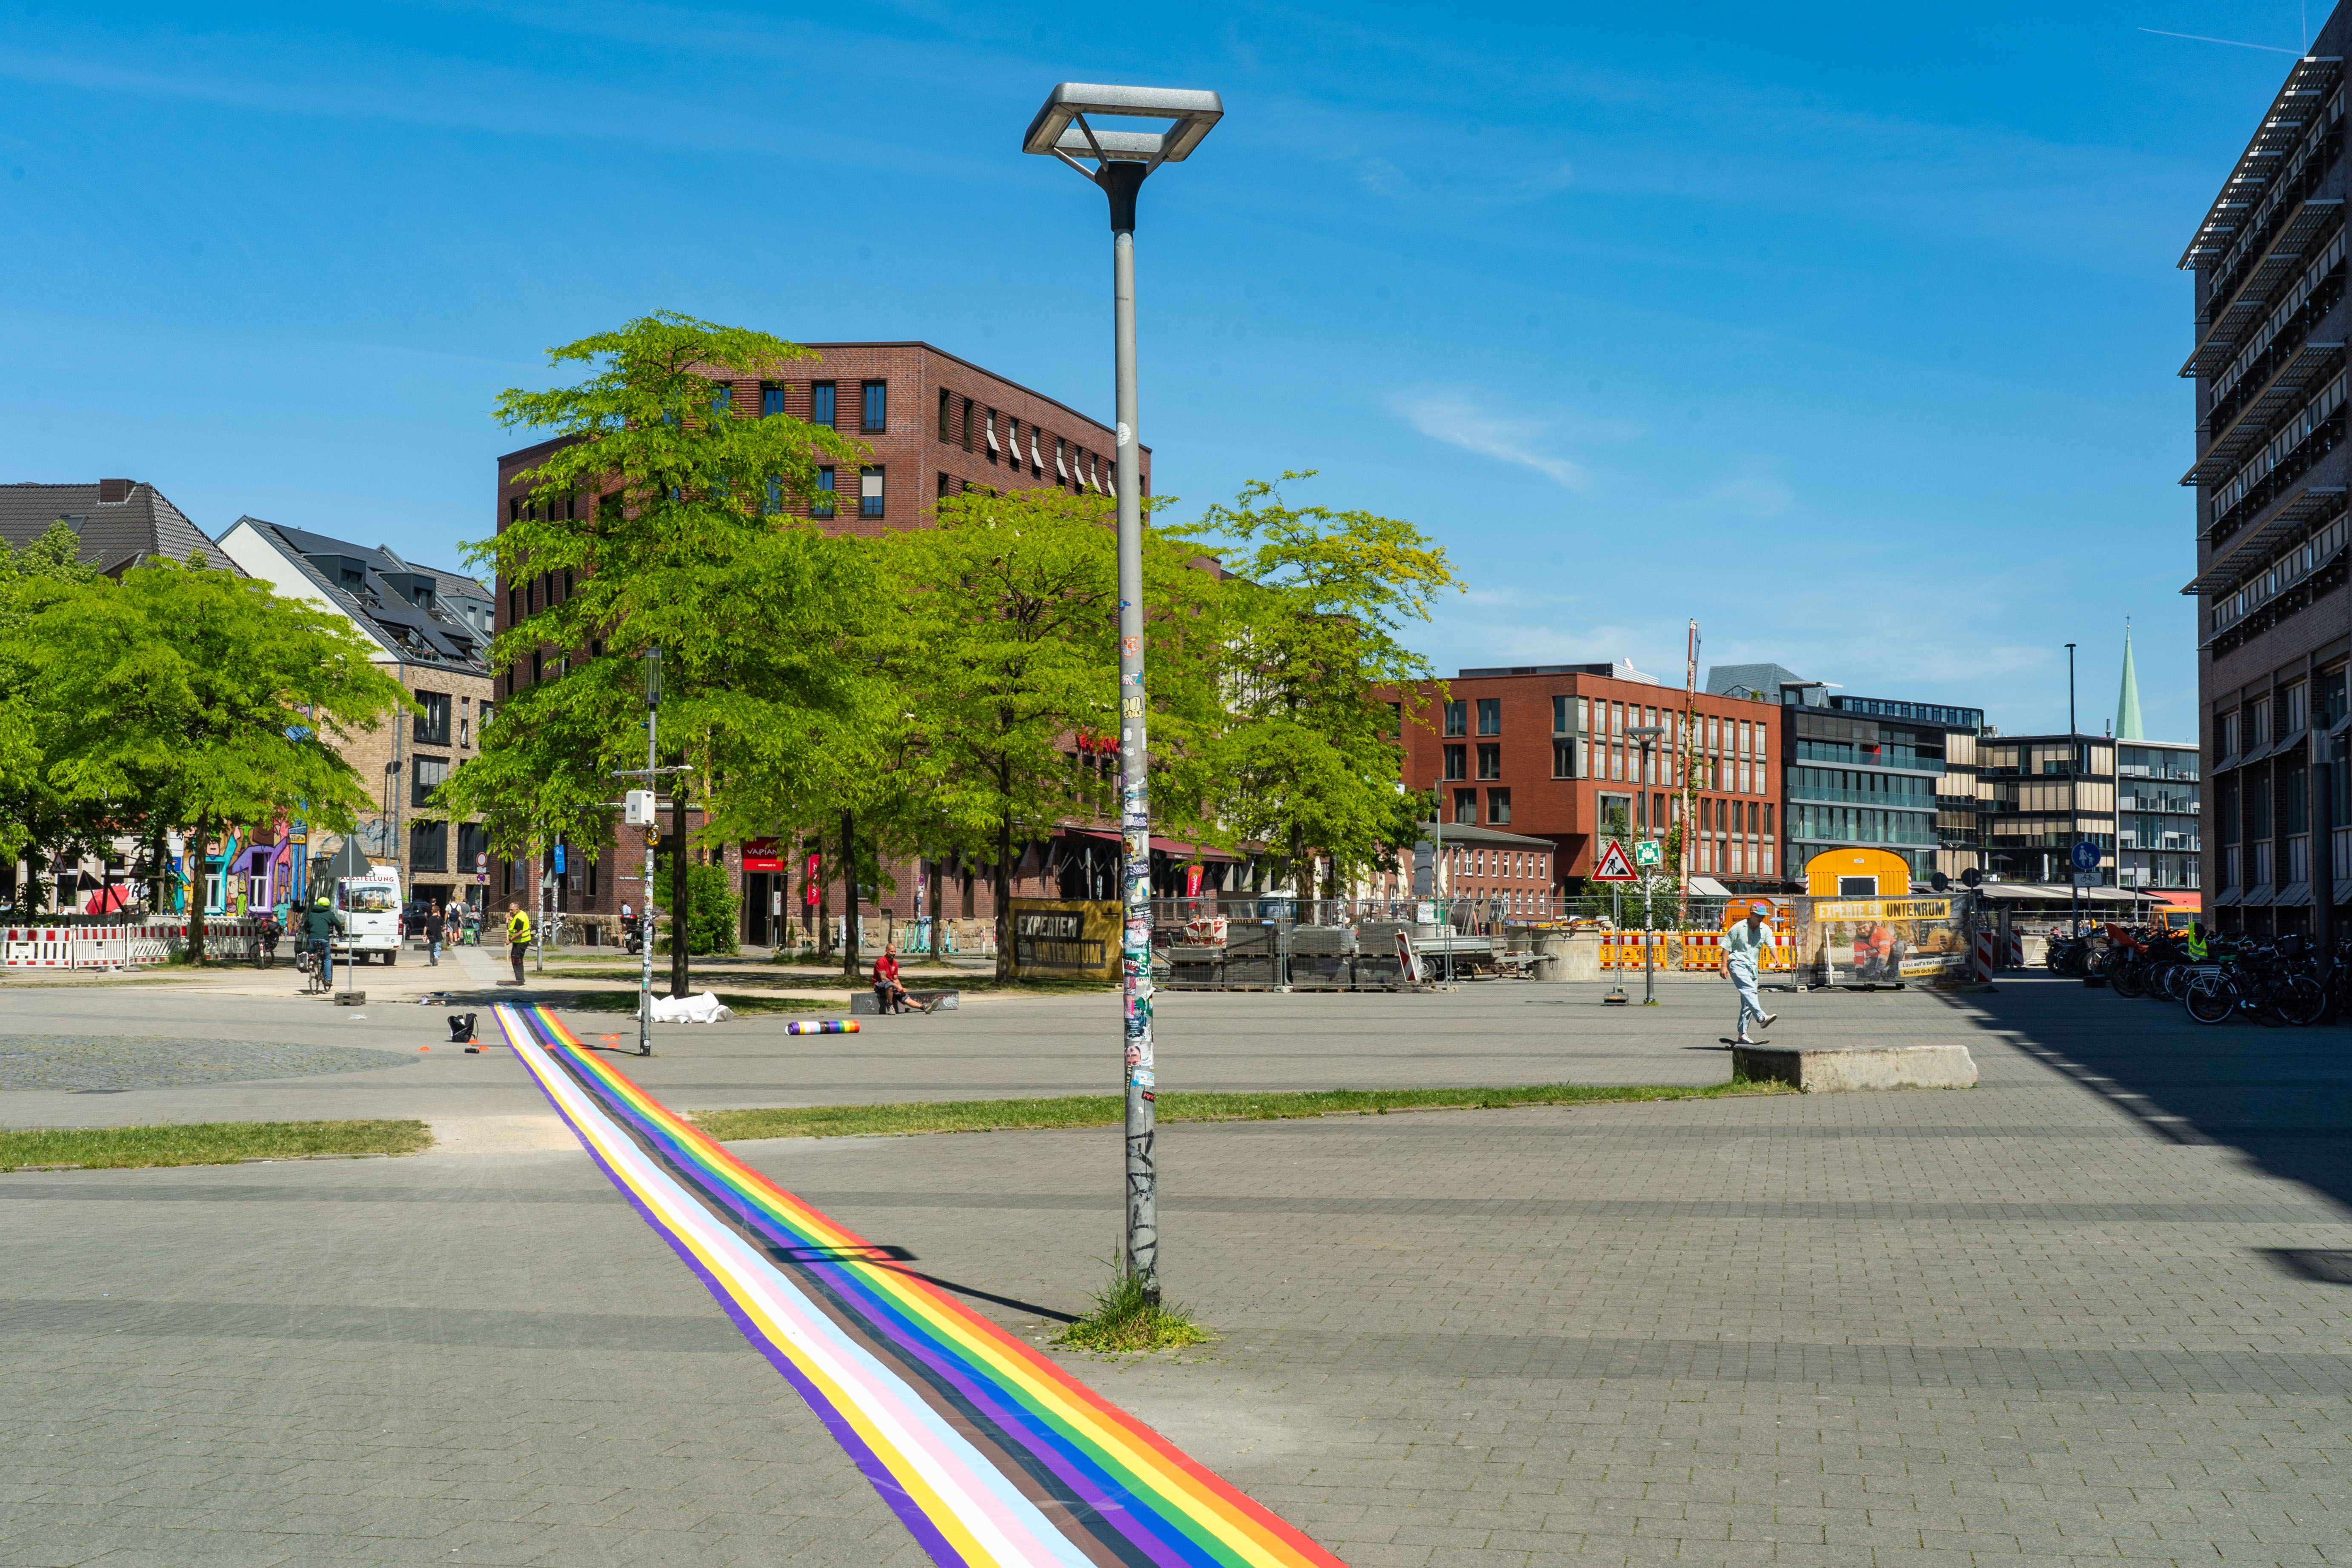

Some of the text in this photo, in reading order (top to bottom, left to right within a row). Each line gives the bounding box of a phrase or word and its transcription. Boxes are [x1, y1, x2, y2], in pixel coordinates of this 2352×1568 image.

[747, 848, 777, 856] VAPIAN
[1819, 902, 1945, 918] EXPERTE FÜR UNTENRUM
[1018, 916, 1077, 937] EXPERTEN
[1018, 940, 1101, 964] FÜR UNTENRUM
[1124, 959, 1140, 967] OTTEN
